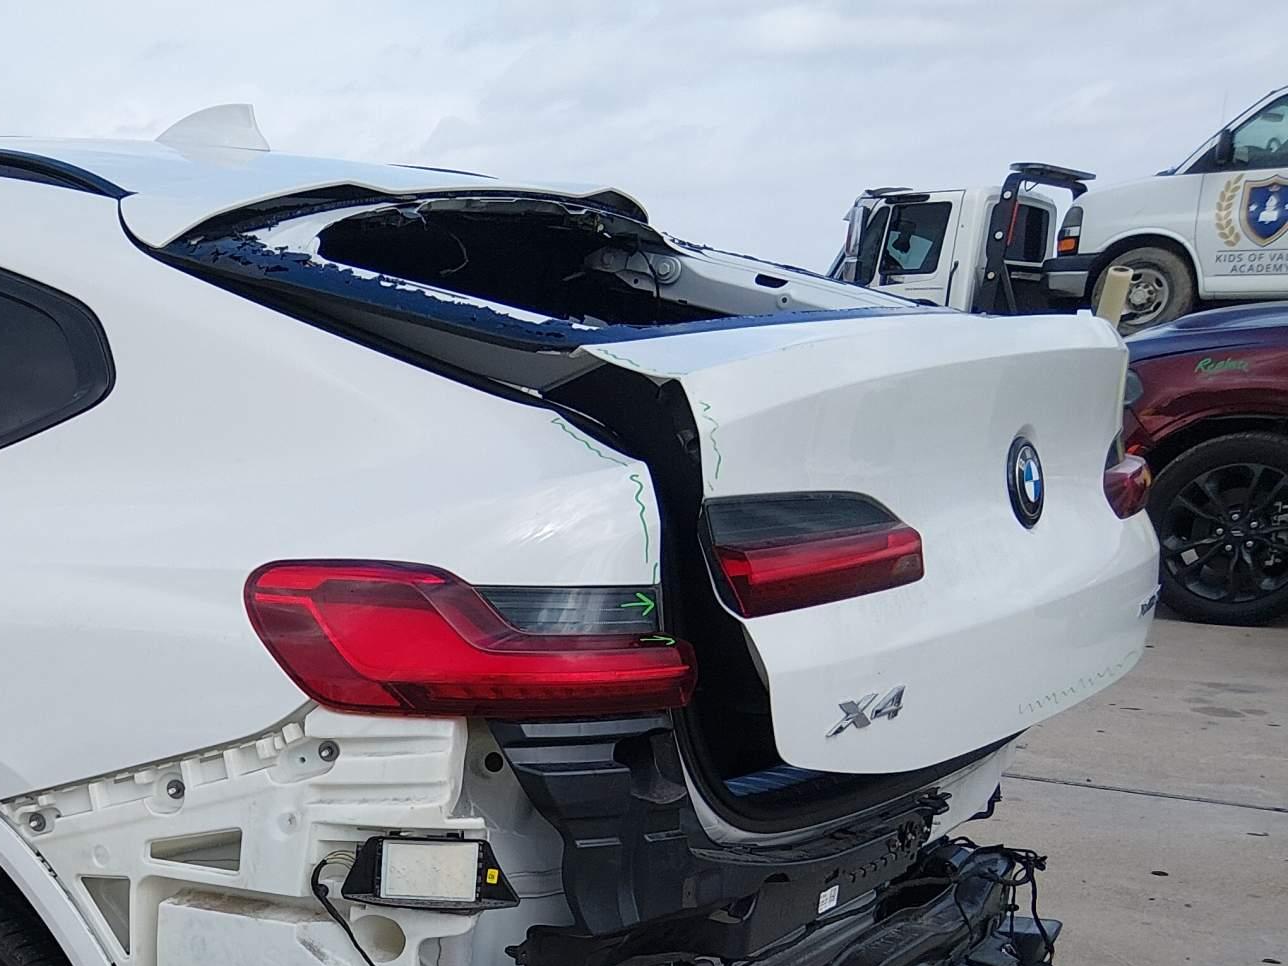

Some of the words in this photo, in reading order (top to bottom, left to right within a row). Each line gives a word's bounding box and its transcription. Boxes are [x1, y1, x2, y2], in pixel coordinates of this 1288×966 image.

[1215, 253, 1243, 264] KIDS
[1247, 252, 1265, 263] OF
[825, 685, 906, 738] X4
